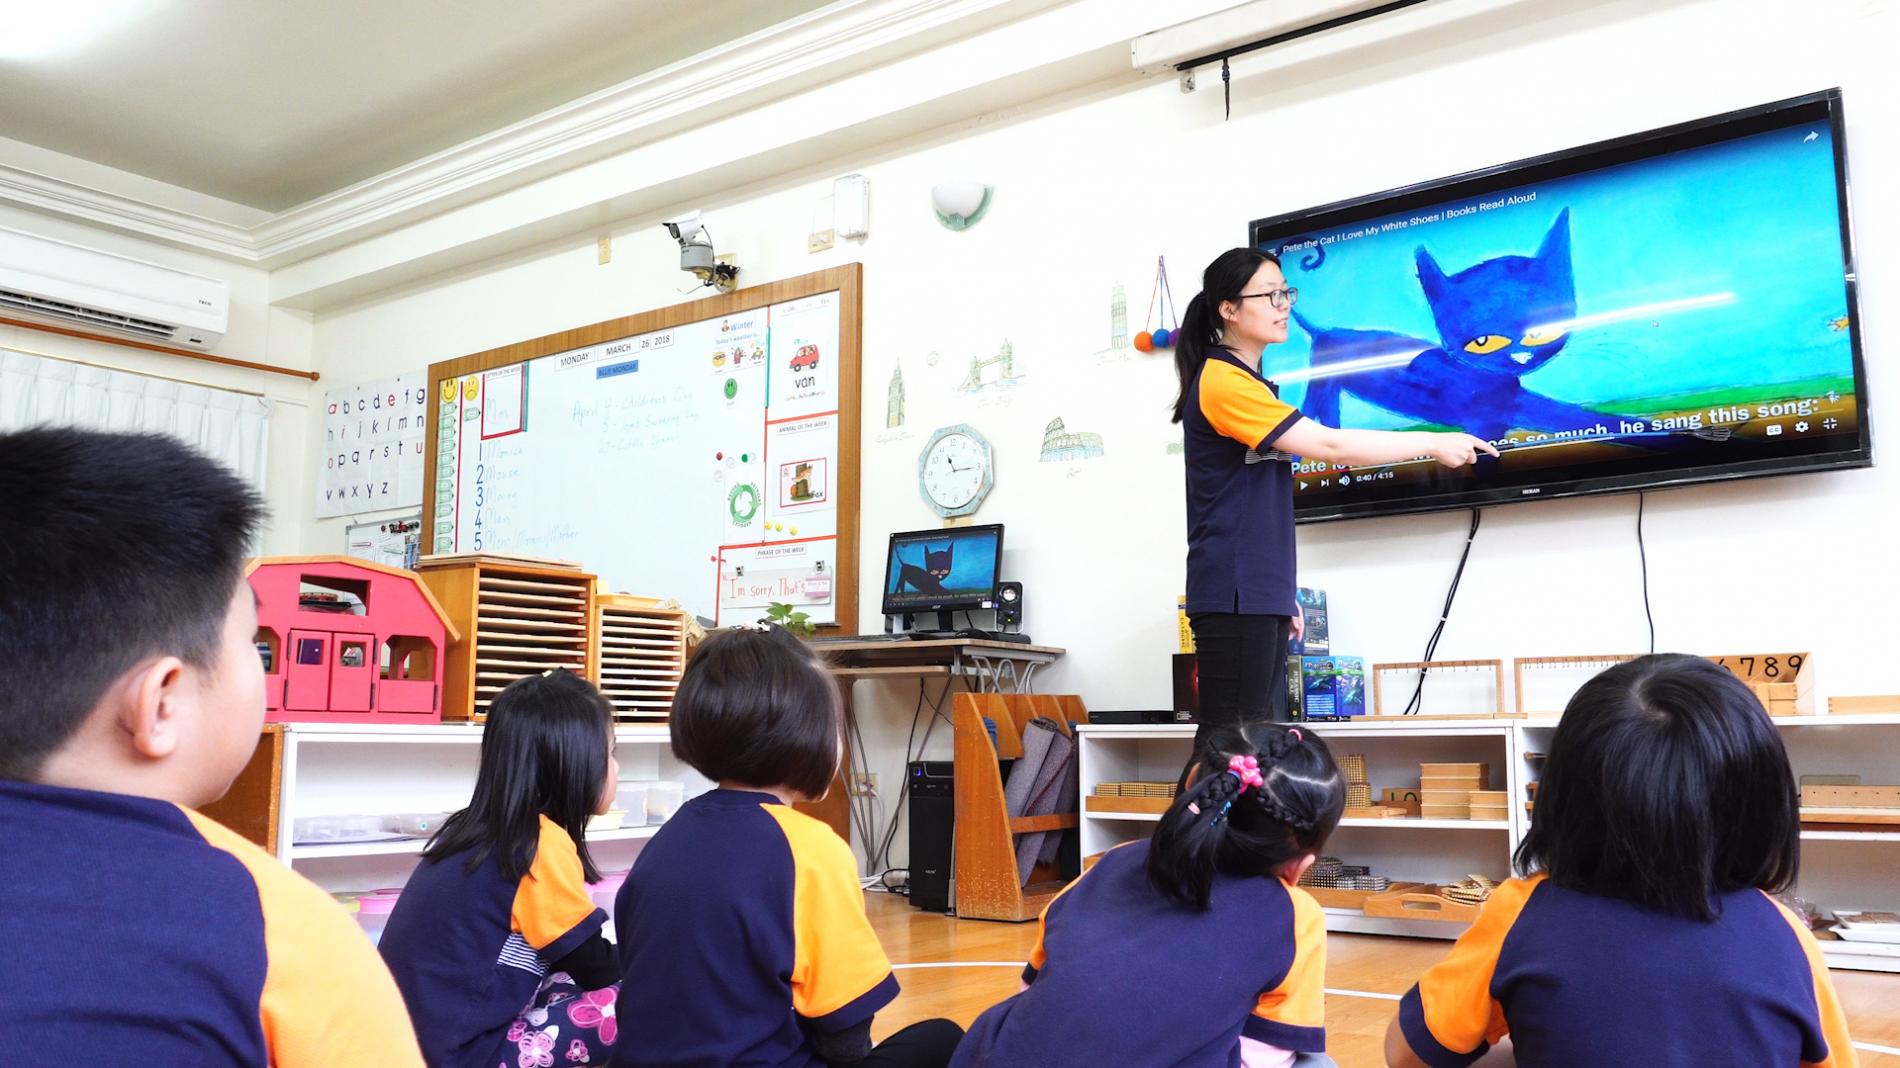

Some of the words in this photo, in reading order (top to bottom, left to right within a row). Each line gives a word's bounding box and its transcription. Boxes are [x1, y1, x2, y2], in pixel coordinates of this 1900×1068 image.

[1283, 243, 1302, 254] Pete
[1304, 240, 1318, 248] the
[1320, 236, 1335, 245] Cat
[1342, 230, 1363, 240] Love
[1366, 227, 1379, 237] My
[1381, 220, 1408, 232] White
[1410, 213, 1439, 226] Shoes
[1447, 206, 1476, 219] Books
[1479, 200, 1504, 211] Read
[1507, 192, 1536, 206] Aloud
[730, 321, 753, 331] Winter
[560, 352, 589, 366] MONDAY
[606, 344, 632, 355] MARCH
[655, 335, 670, 345] 2018
[795, 376, 815, 388] van
[328, 403, 336, 414] a
[343, 400, 350, 414] b
[358, 399, 365, 411] c
[374, 394, 380, 409] d
[388, 394, 395, 406] e
[416, 388, 425, 404] g
[372, 420, 378, 434] k
[399, 417, 407, 429] m
[417, 415, 424, 427] n
[1291, 462, 1326, 474] Pete
[1620, 420, 1645, 434] he
[1651, 413, 1702, 432] sang
[1708, 406, 1749, 424] this
[1757, 399, 1818, 416] song:
[338, 454, 345, 468] p
[370, 449, 374, 460] r
[384, 446, 389, 457] s
[416, 442, 422, 454] u
[476, 464, 484, 484] 2
[326, 490, 332, 500] v
[339, 488, 345, 499] w
[352, 486, 358, 497] x
[367, 484, 373, 498] y
[382, 482, 388, 494] z
[476, 487, 484, 507] 3
[475, 510, 482, 529] 4
[474, 532, 482, 551] 5
[1740, 657, 1754, 676] 7
[1764, 656, 1779, 677] 8
[1788, 655, 1802, 676] 9
